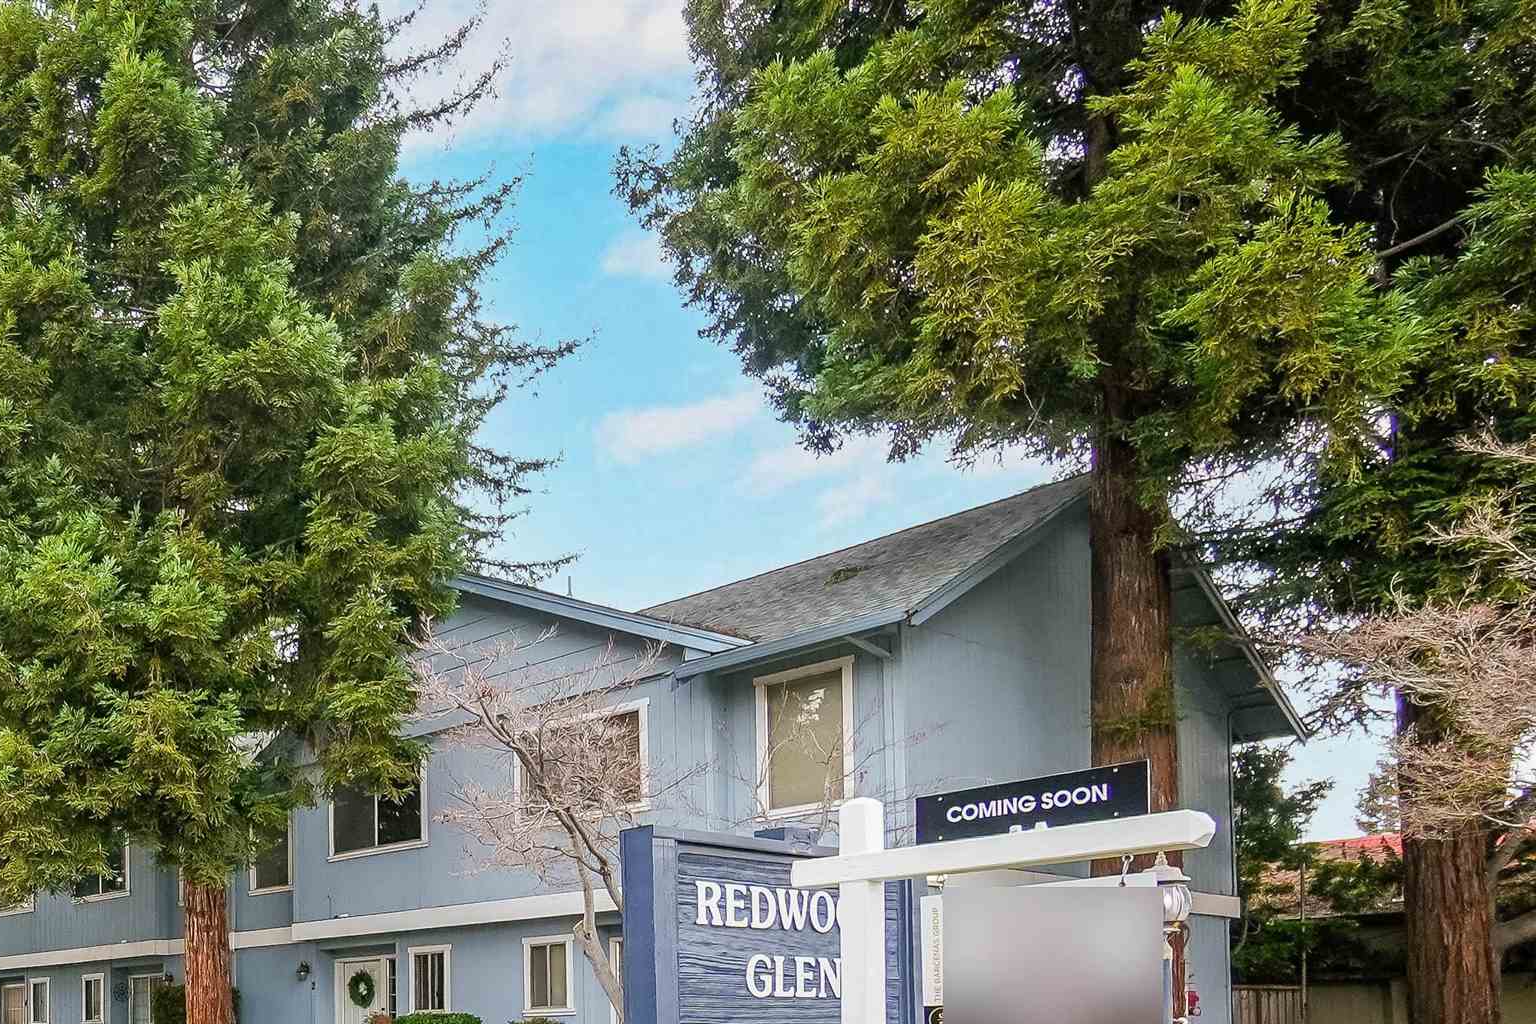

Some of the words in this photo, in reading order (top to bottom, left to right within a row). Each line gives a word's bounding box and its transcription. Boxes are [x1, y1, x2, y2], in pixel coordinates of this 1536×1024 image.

[946, 795, 1037, 823] COMING
[1040, 783, 1109, 811] SOON
[695, 880, 841, 934] REDWO
[931, 907, 940, 937] GROUP
[745, 953, 841, 999] GLEN
[934, 984, 942, 1002] THE
